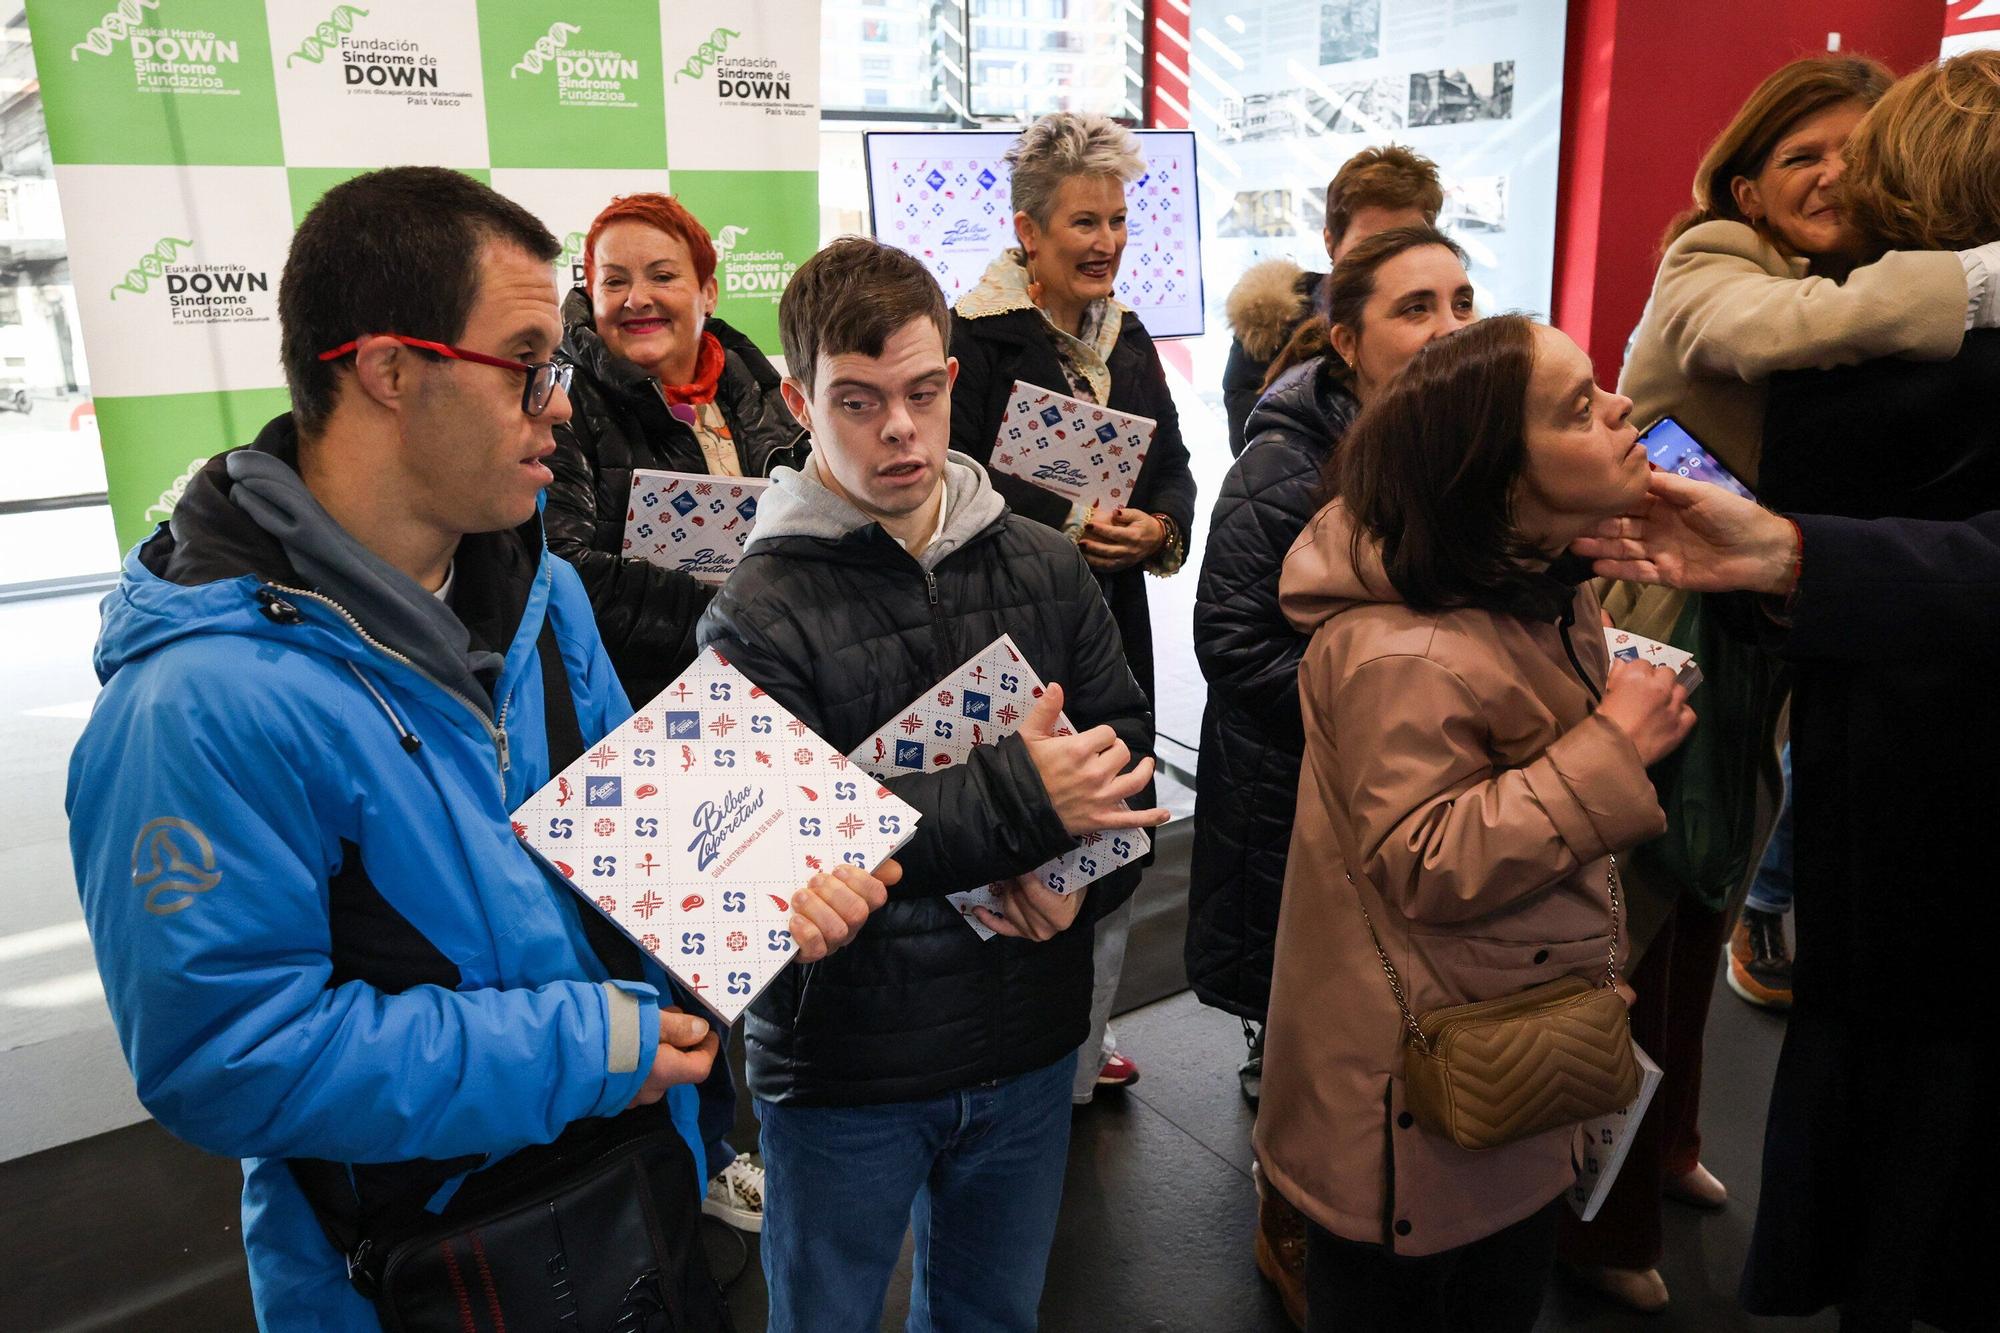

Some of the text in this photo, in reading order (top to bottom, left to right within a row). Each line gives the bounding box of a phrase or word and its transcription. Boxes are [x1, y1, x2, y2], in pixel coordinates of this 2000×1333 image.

[129, 26, 216, 39] Euskal Herriko
[130, 36, 239, 63] DOWN
[341, 37, 419, 52] Fundación
[342, 51, 437, 66] Síndrome de
[717, 56, 777, 68] Fundación
[134, 59, 217, 75] Sindrome
[557, 57, 639, 79] DOWN
[137, 71, 224, 88] Fundazioa
[344, 65, 438, 87] DOWN
[777, 71, 791, 80] de
[558, 76, 621, 89] Sindrome
[559, 87, 625, 100] Fundazioa
[718, 80, 790, 99] DOWN
[431, 98, 461, 107] Vasco
[784, 108, 806, 116] Vasco
[725, 250, 784, 261] Fundación
[164, 264, 246, 273] Euskal Herriko
[782, 261, 797, 272] de
[166, 272, 268, 294] DOWN
[170, 295, 247, 306] Sindrome
[172, 306, 254, 318] Fundazioa
[693, 783, 752, 834] Bilbao
[758, 823, 769, 834] DE
[765, 808, 785, 828] BILBAO
